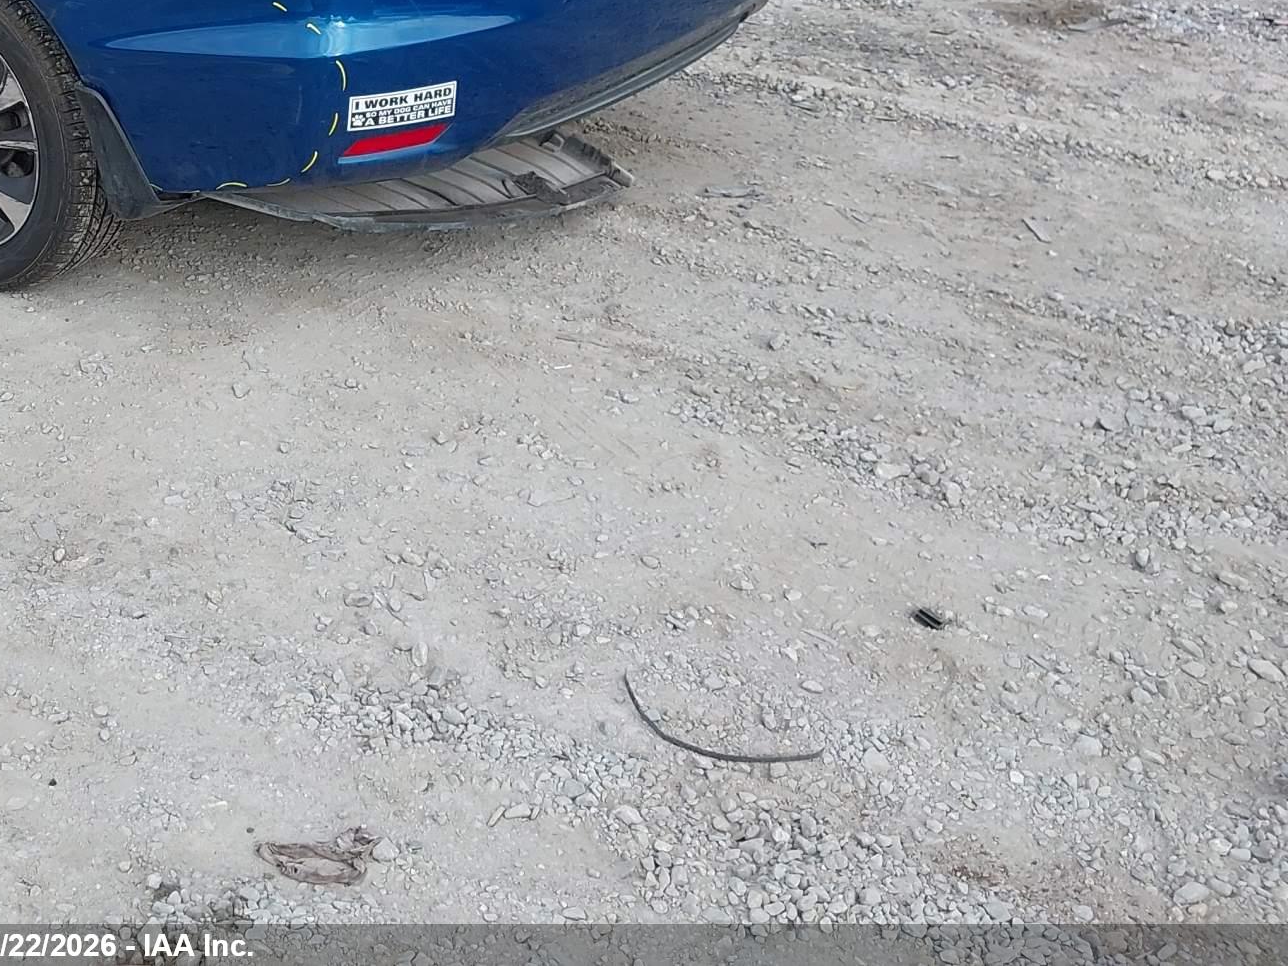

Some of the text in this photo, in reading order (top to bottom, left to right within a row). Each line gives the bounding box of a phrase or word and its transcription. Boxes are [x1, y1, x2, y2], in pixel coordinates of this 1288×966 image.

[355, 87, 452, 110] I WORK HARD
[378, 109, 393, 117] MY
[394, 106, 411, 114] DOG
[412, 103, 430, 111] CAN
[431, 98, 453, 107] HAVE
[364, 105, 452, 126] A BETTER LIFE
